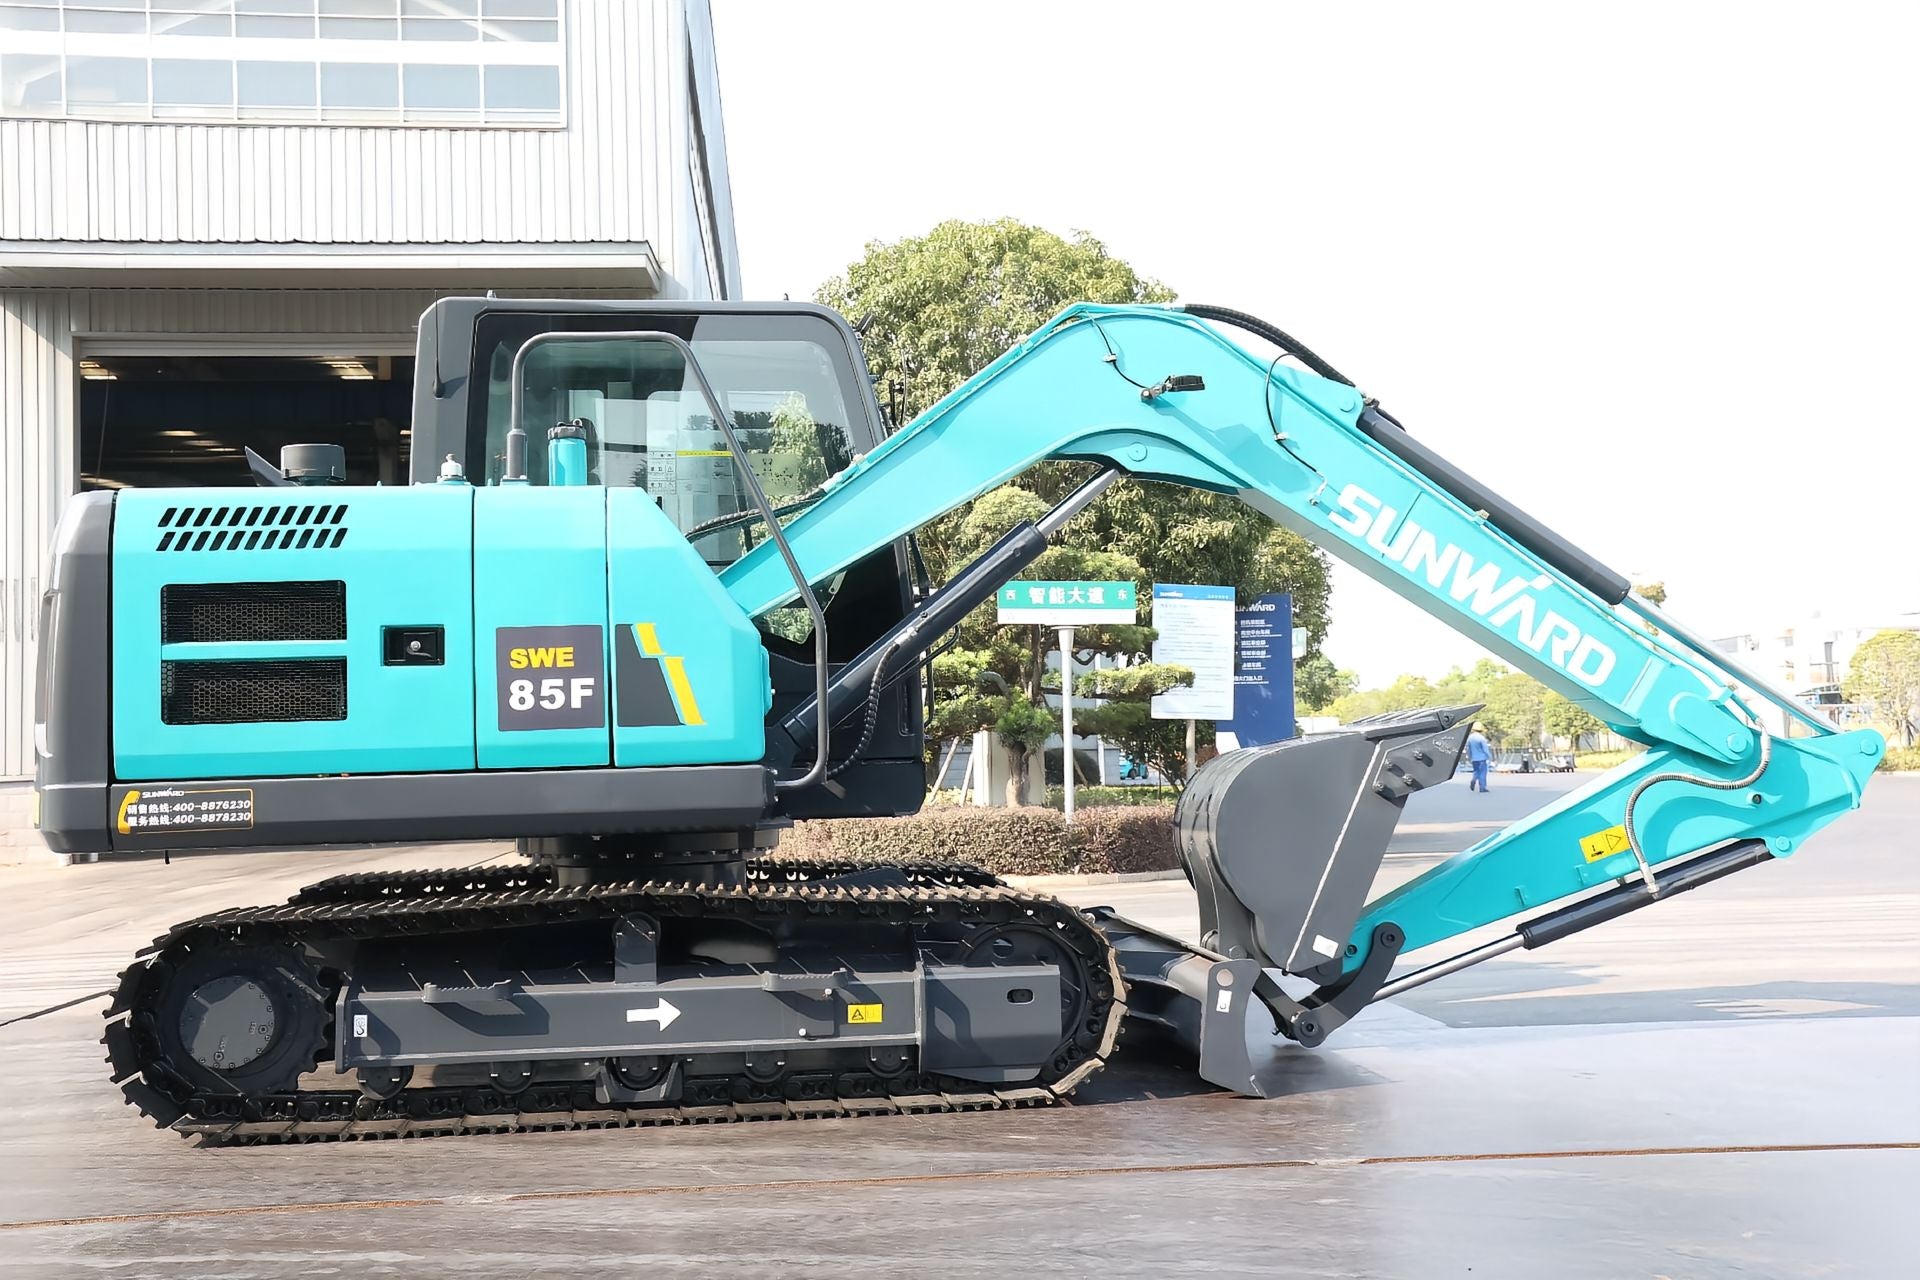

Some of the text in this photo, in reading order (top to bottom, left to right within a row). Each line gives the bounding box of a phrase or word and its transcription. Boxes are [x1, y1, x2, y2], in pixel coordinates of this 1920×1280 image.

[1006, 586, 1127, 604] 西 智能大道 东
[1328, 483, 1617, 687] SUNWARD
[510, 647, 574, 669] SWE
[508, 678, 595, 711] 85F
[142, 788, 185, 798] SUNWARD
